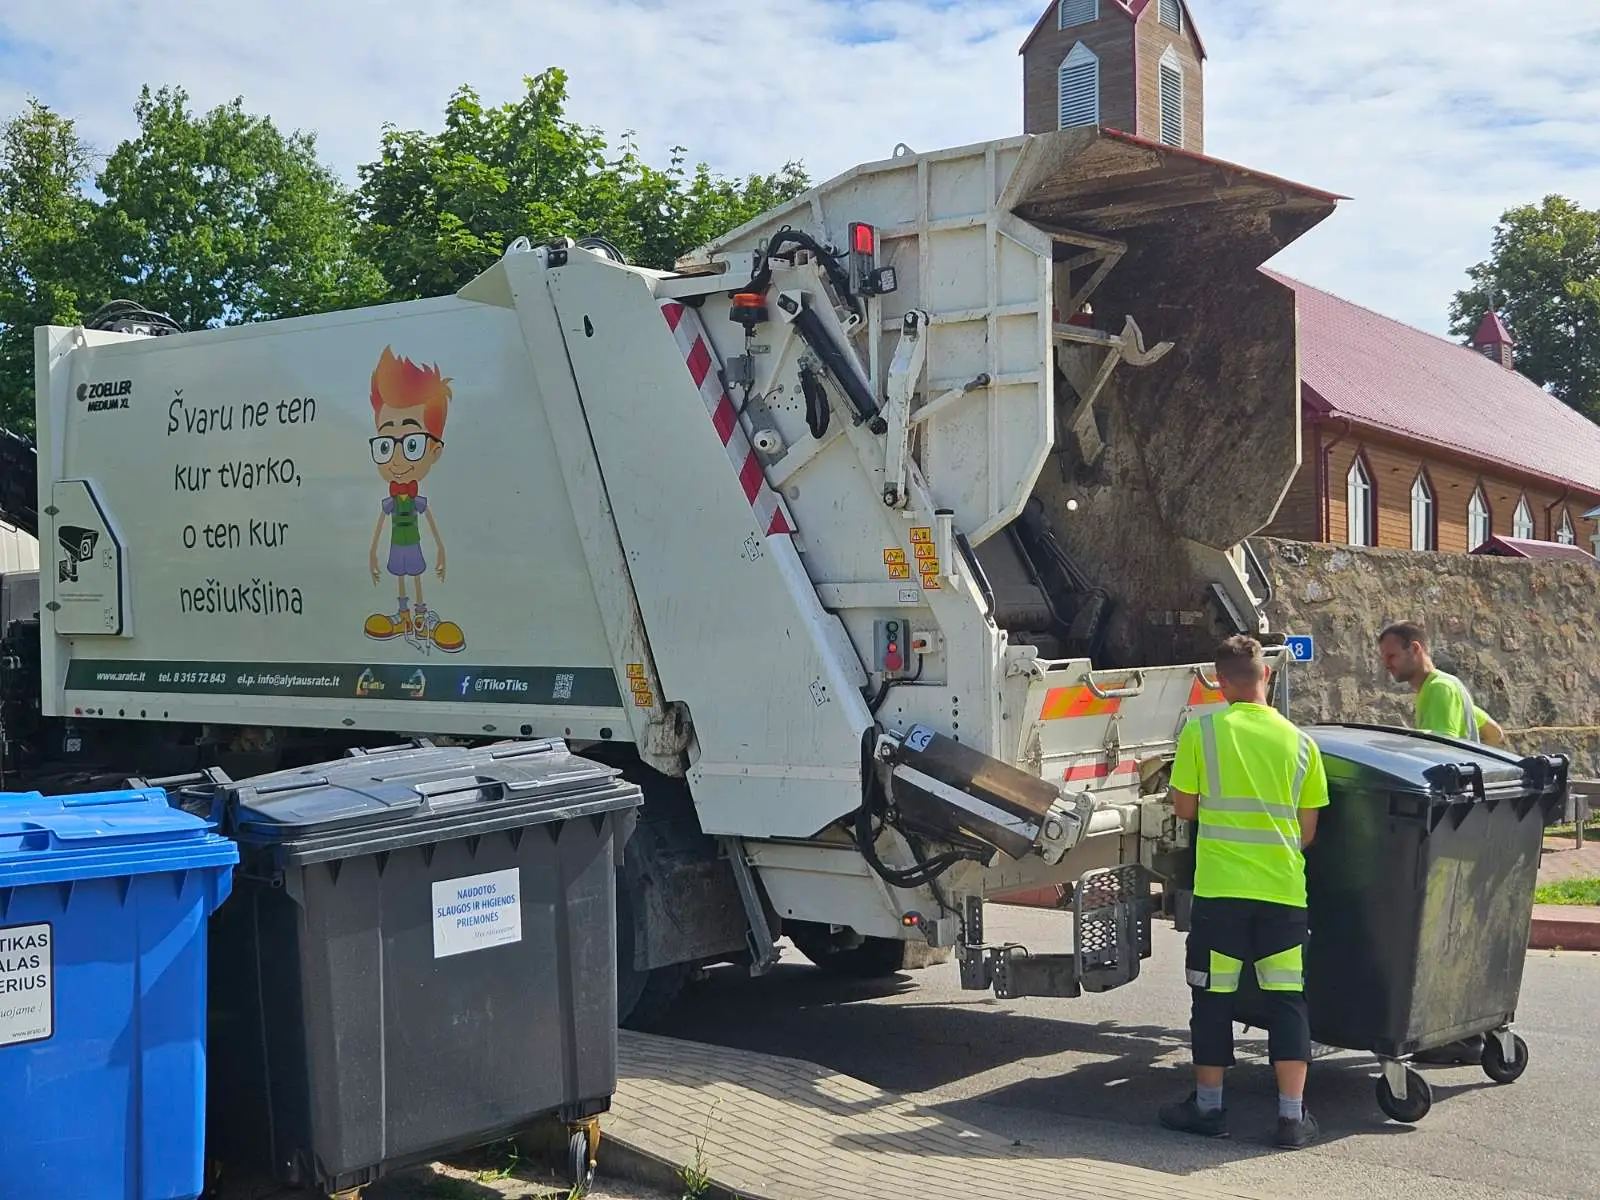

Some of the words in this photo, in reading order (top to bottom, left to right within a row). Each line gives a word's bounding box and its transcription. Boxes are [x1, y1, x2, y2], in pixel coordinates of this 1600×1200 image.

[89, 380, 132, 398] ZOELLER
[87, 400, 118, 412] MEDIUM
[120, 399, 130, 409] XL
[167, 389, 233, 436] Švaru
[241, 400, 268, 430] ne
[275, 397, 316, 424] ten
[175, 464, 211, 491] kur
[217, 457, 301, 489] tvarko,
[182, 524, 196, 548] o
[203, 522, 240, 549] ten
[249, 519, 288, 547] kur
[180, 579, 303, 615] nešiukšlina
[96, 672, 146, 681] www.aratc.lt
[158, 672, 172, 682] tel.
[173, 673, 180, 682] 8
[181, 673, 197, 682] 315
[198, 673, 209, 683] 72
[210, 673, 226, 684] 843
[237, 674, 255, 687] el.p.
[257, 674, 340, 688] info@alytausratc.lt
[474, 678, 529, 691] @TikoTiks
[910, 730, 931, 748] CE
[457, 883, 496, 899] NAUDOTOS
[437, 902, 471, 917] SLAUGOS
[472, 900, 480, 911] IR
[481, 894, 516, 909] HIGIENOS
[456, 911, 499, 929] PRIEMONĖS
